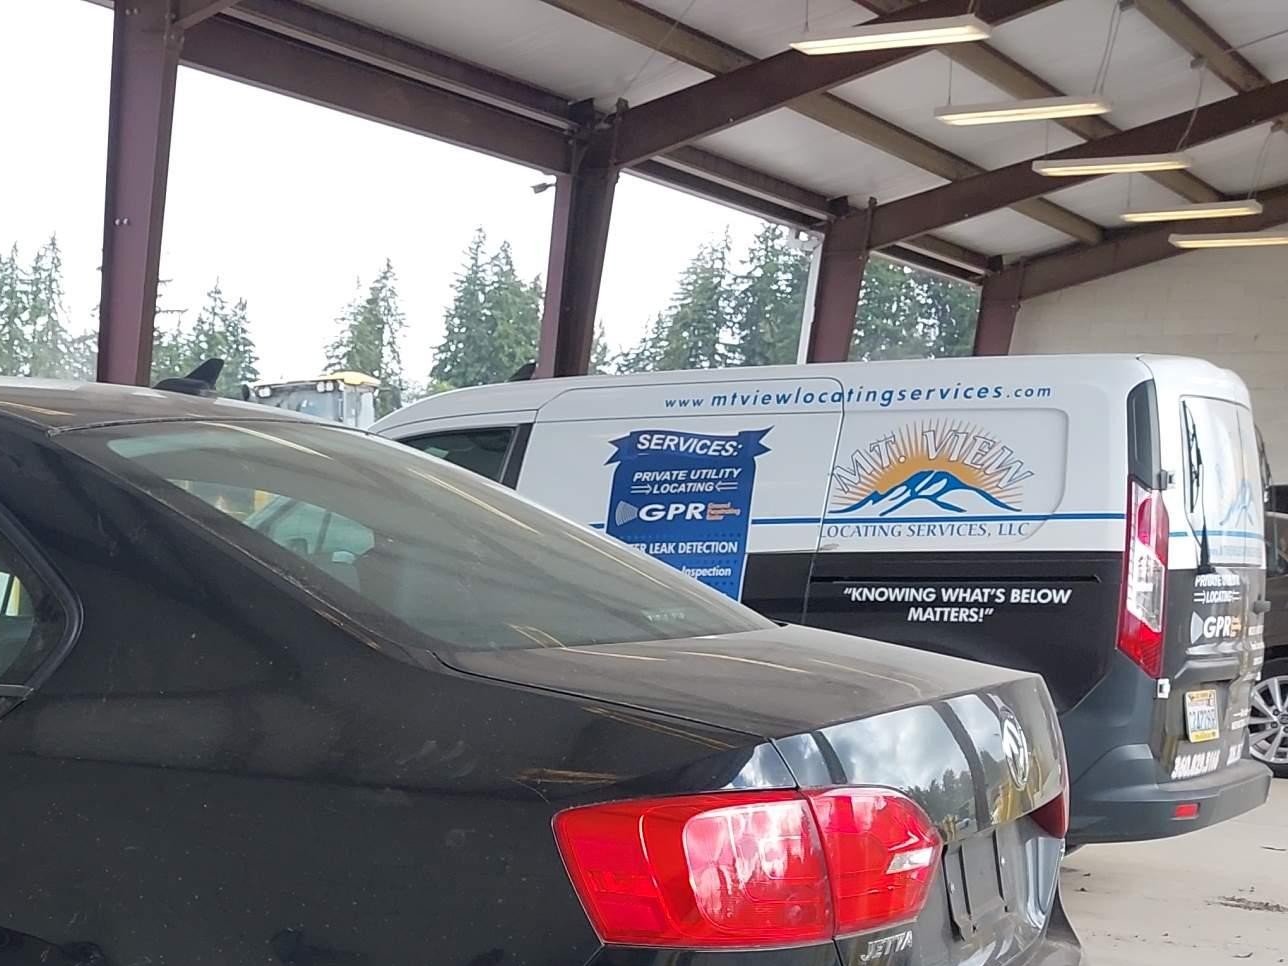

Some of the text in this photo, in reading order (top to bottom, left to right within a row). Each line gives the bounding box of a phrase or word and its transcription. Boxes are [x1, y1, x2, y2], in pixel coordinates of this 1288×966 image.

[636, 434, 743, 457] SERVICES:
[831, 429, 1035, 494] MT. VIEW
[632, 467, 742, 483] PRIVATE UTILITY
[652, 481, 714, 495] LOCATING
[638, 502, 705, 522] GPR
[906, 523, 992, 537] SERVICES,
[998, 522, 1030, 536] LLC
[649, 542, 677, 554] LEAK
[678, 541, 739, 553] DETECTION
[681, 565, 732, 578] Inspection
[1009, 588, 1073, 604] BELOW
[1203, 616, 1231, 638] GPR
[860, 931, 913, 962] JETTA
